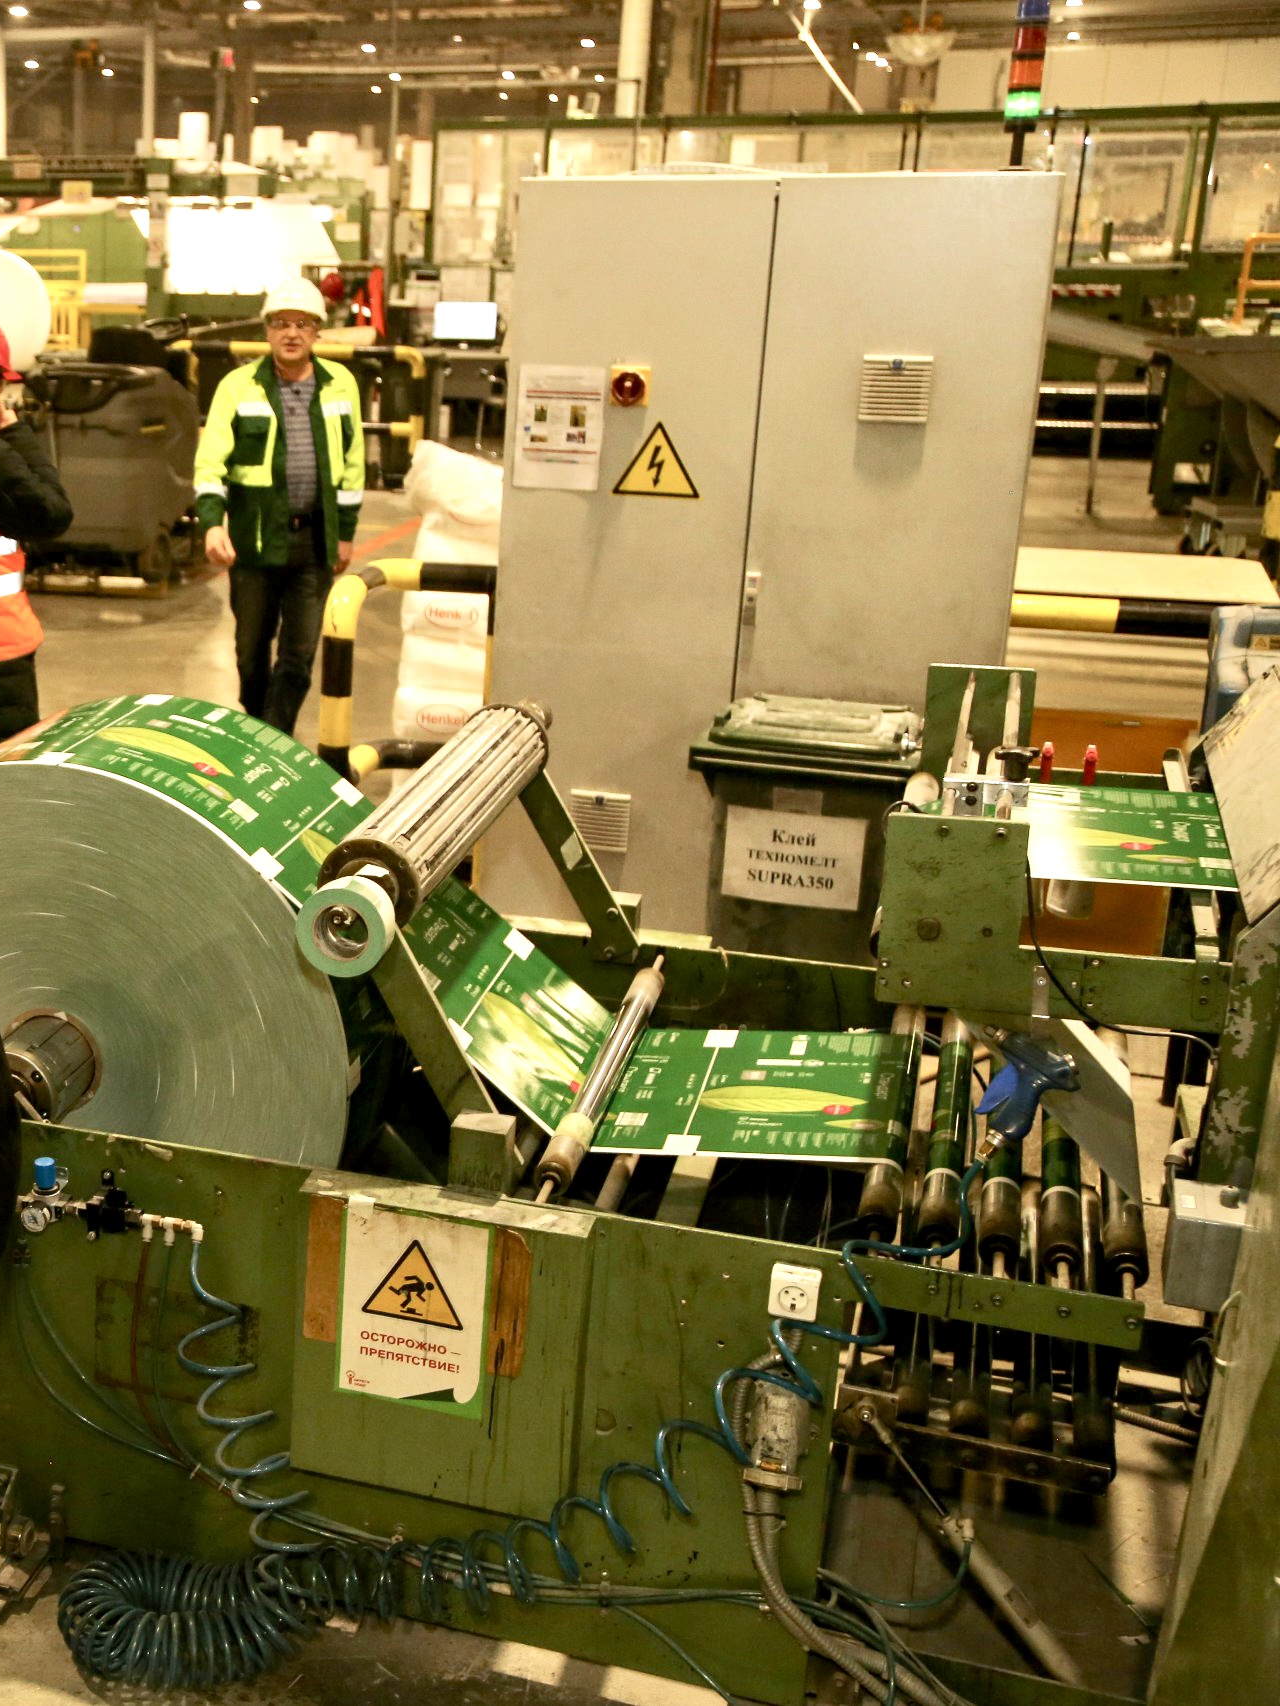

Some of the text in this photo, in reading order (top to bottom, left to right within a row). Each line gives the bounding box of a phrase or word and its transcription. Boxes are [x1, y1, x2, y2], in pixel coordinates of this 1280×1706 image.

[429, 607, 474, 621] Henkl
[771, 828, 816, 847] Клей
[747, 848, 839, 868] ТЕХНОМЕЛТ
[747, 868, 834, 890] SUPRA350
[360, 1330, 447, 1355] ОСТОРОЖНО
[359, 1346, 460, 1374] ПРЕПЯТСТВИЕ!
